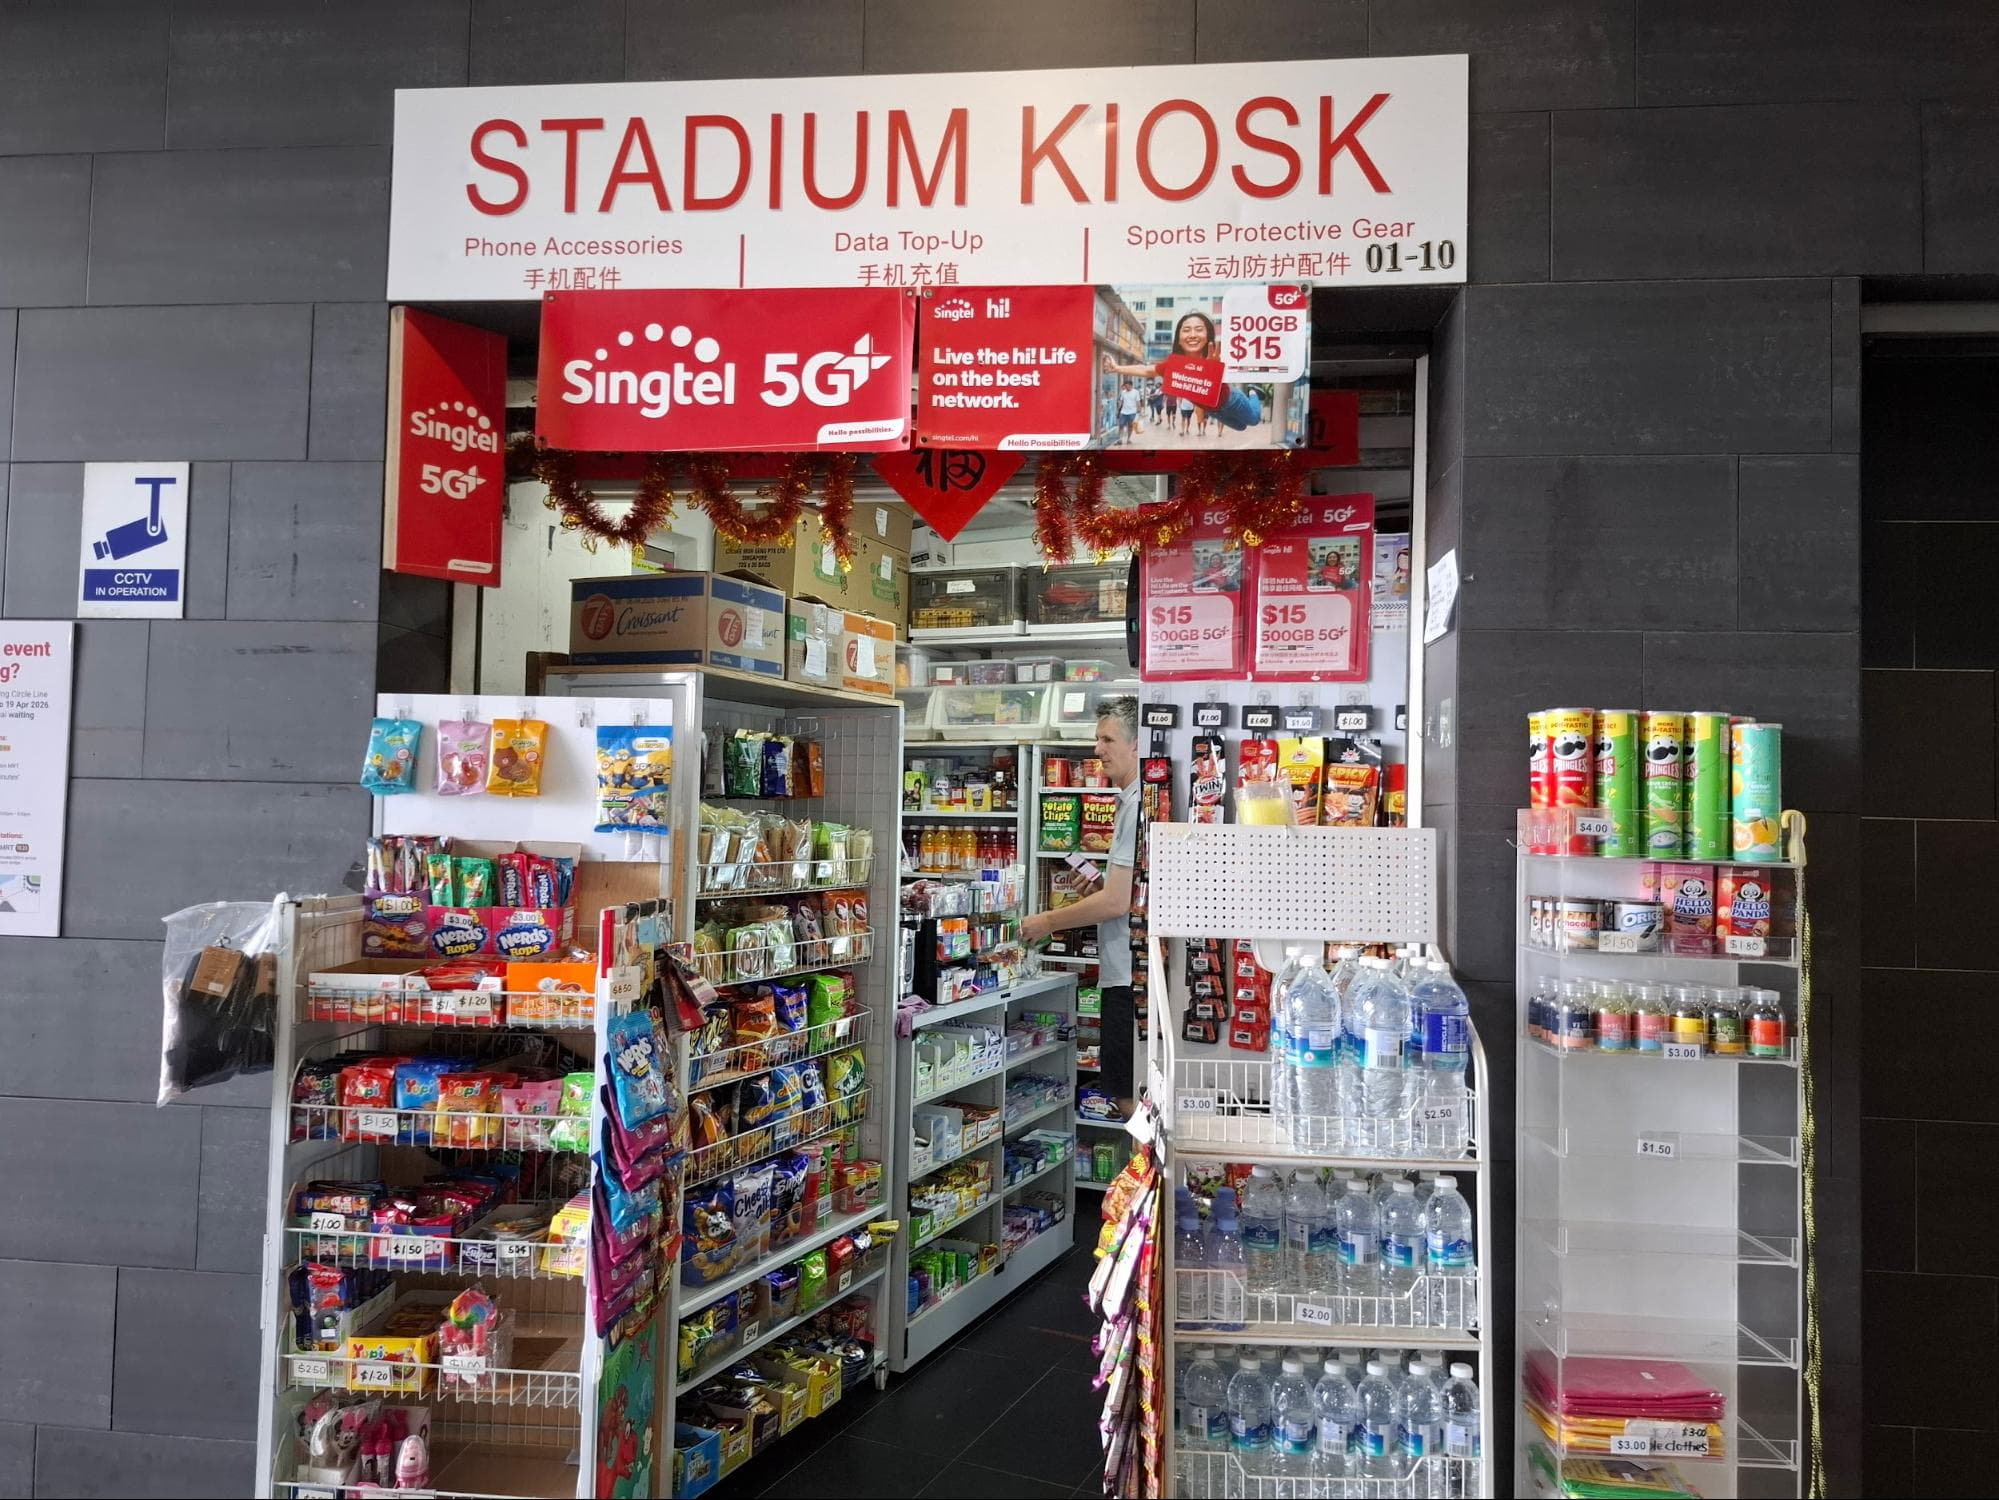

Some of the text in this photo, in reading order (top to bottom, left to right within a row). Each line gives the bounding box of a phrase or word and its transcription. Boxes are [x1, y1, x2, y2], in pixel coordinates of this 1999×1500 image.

[466, 93, 1393, 217] STADIUM KIOSK
[1127, 218, 1416, 250] Sports Protective Gear
[465, 235, 683, 257] Phone Accessories
[835, 230, 984, 255] Data Top-Up
[1365, 239, 1456, 273] 01-10
[1187, 252, 1352, 280] 运动防护配件
[523, 265, 622, 290] 手机配件
[857, 262, 960, 287] 手机充值
[934, 298, 1010, 322] Singtel hi!
[1230, 316, 1298, 333] 500GB
[1229, 333, 1282, 363] $15
[933, 347, 1077, 365] Live the hi! Life
[561, 345, 735, 419] Singtel
[932, 369, 1040, 387] on the best
[1171, 371, 1213, 388] Welcome to
[932, 391, 1020, 409] network.
[411, 405, 498, 454] Singtel
[932, 434, 979, 444] singtel.com/hi
[1007, 439, 1081, 448] Hello Possibilities
[114, 572, 153, 585] CCTV
[95, 587, 168, 597] IN OPERATION
[616, 605, 685, 637] Croissant
[1151, 605, 1193, 628] $15
[1261, 603, 1306, 627] $15
[1151, 629, 1199, 641] 500GB
[1261, 630, 1315, 642] 500GB
[3, 640, 52, 658] event
[11, 690, 48, 698] Circle Line
[16, 702, 30, 710] Apr
[31, 701, 49, 709] 2026
[8, 711, 35, 721] waiting
[1342, 716, 1364, 726] $1.00
[1553, 758, 1588, 773] PRINGLES
[1644, 761, 1680, 779] PRINGLES
[1330, 767, 1368, 779] SPICY
[1043, 802, 1073, 812] Potato
[1083, 803, 1116, 813] Potato
[1043, 810, 1071, 822] Chips
[1085, 812, 1114, 823] Chips
[1579, 822, 1608, 833] $4.00
[1675, 897, 1712, 907] HELLO
[1733, 901, 1769, 911] HELLO
[1674, 905, 1713, 915] PANDA
[1732, 909, 1770, 918] PANDA
[449, 915, 473, 927] $3.00
[513, 912, 536, 923] $3.00
[445, 942, 477, 956] Rope
[510, 944, 540, 958] Rope
[458, 995, 488, 1007] $1.20
[1667, 1046, 1696, 1058] $3.00
[350, 1077, 381, 1098] Yupi
[405, 1077, 435, 1097] Yupi
[447, 1077, 482, 1098] Yupi
[514, 1098, 549, 1115] Yupi
[1183, 1098, 1211, 1110] $3.00
[1424, 1108, 1452, 1120] $2.50
[1641, 1141, 1672, 1156] $1.50
[1301, 1307, 1331, 1322] $2.00
[352, 1343, 385, 1359] Yupi
[1617, 1440, 1646, 1450] $3.00
[1664, 1439, 1708, 1452] clothes
